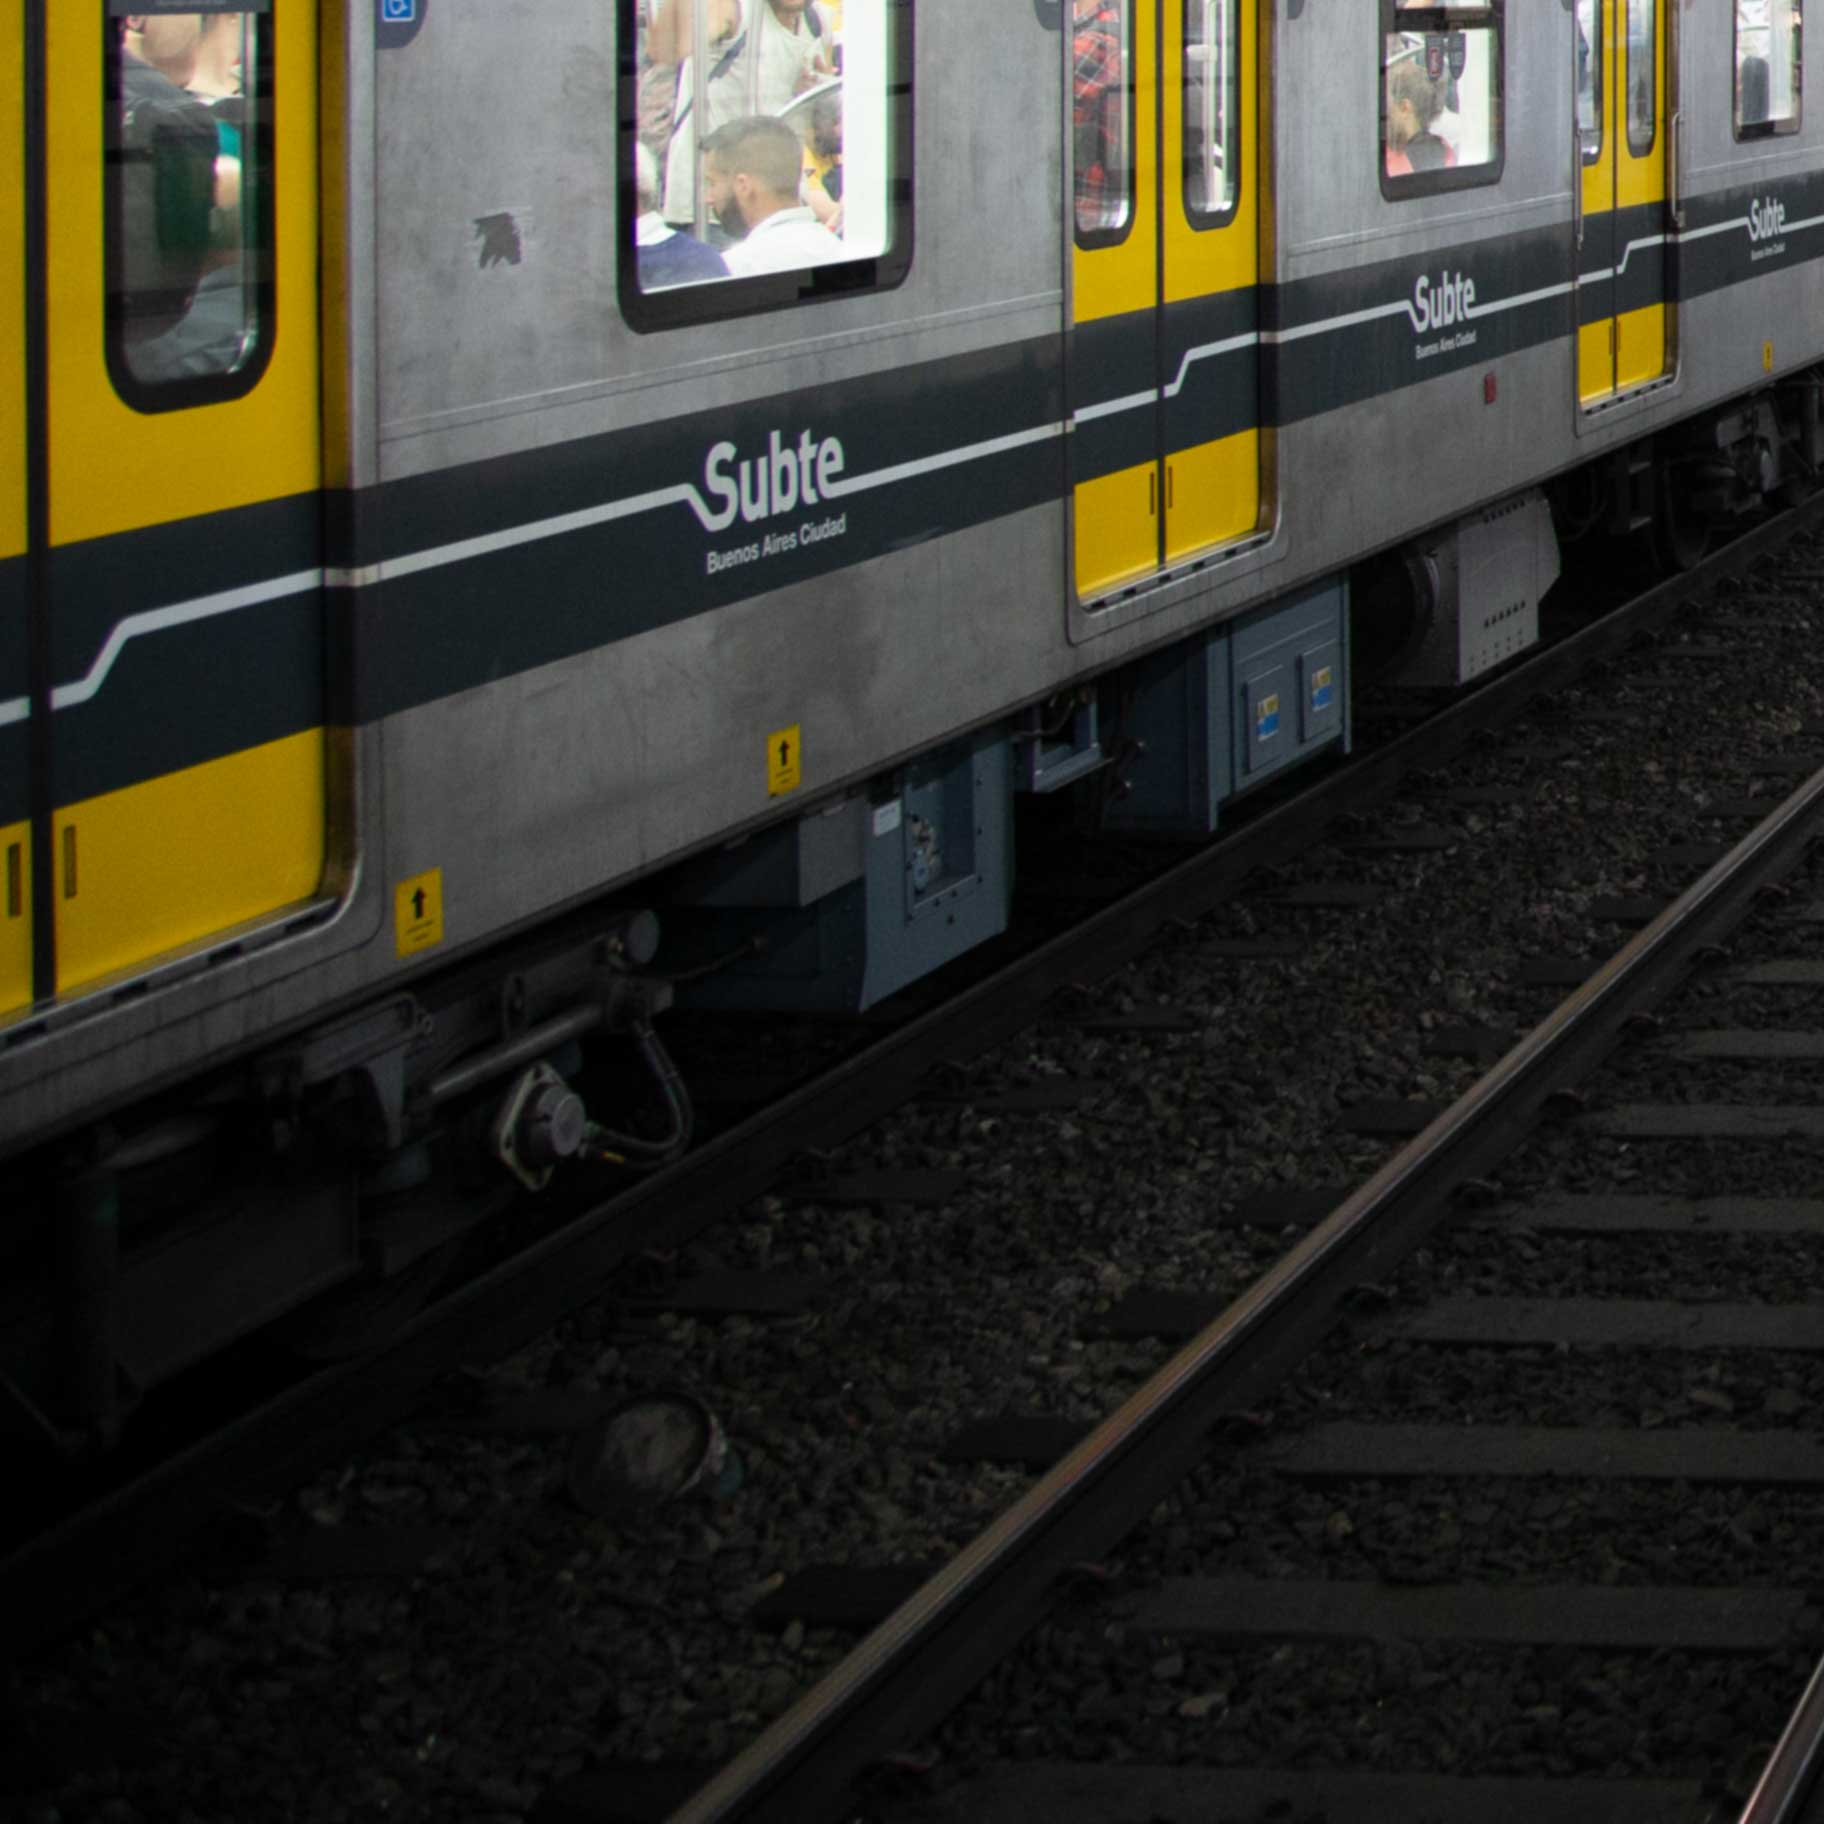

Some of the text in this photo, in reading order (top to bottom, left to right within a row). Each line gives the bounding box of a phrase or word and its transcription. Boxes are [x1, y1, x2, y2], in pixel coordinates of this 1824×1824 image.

[1750, 196, 1786, 242] Subte
[1413, 270, 1476, 333] Subte
[702, 428, 845, 533] Subte
[706, 512, 848, 575] Buenos Aires Ciudad
